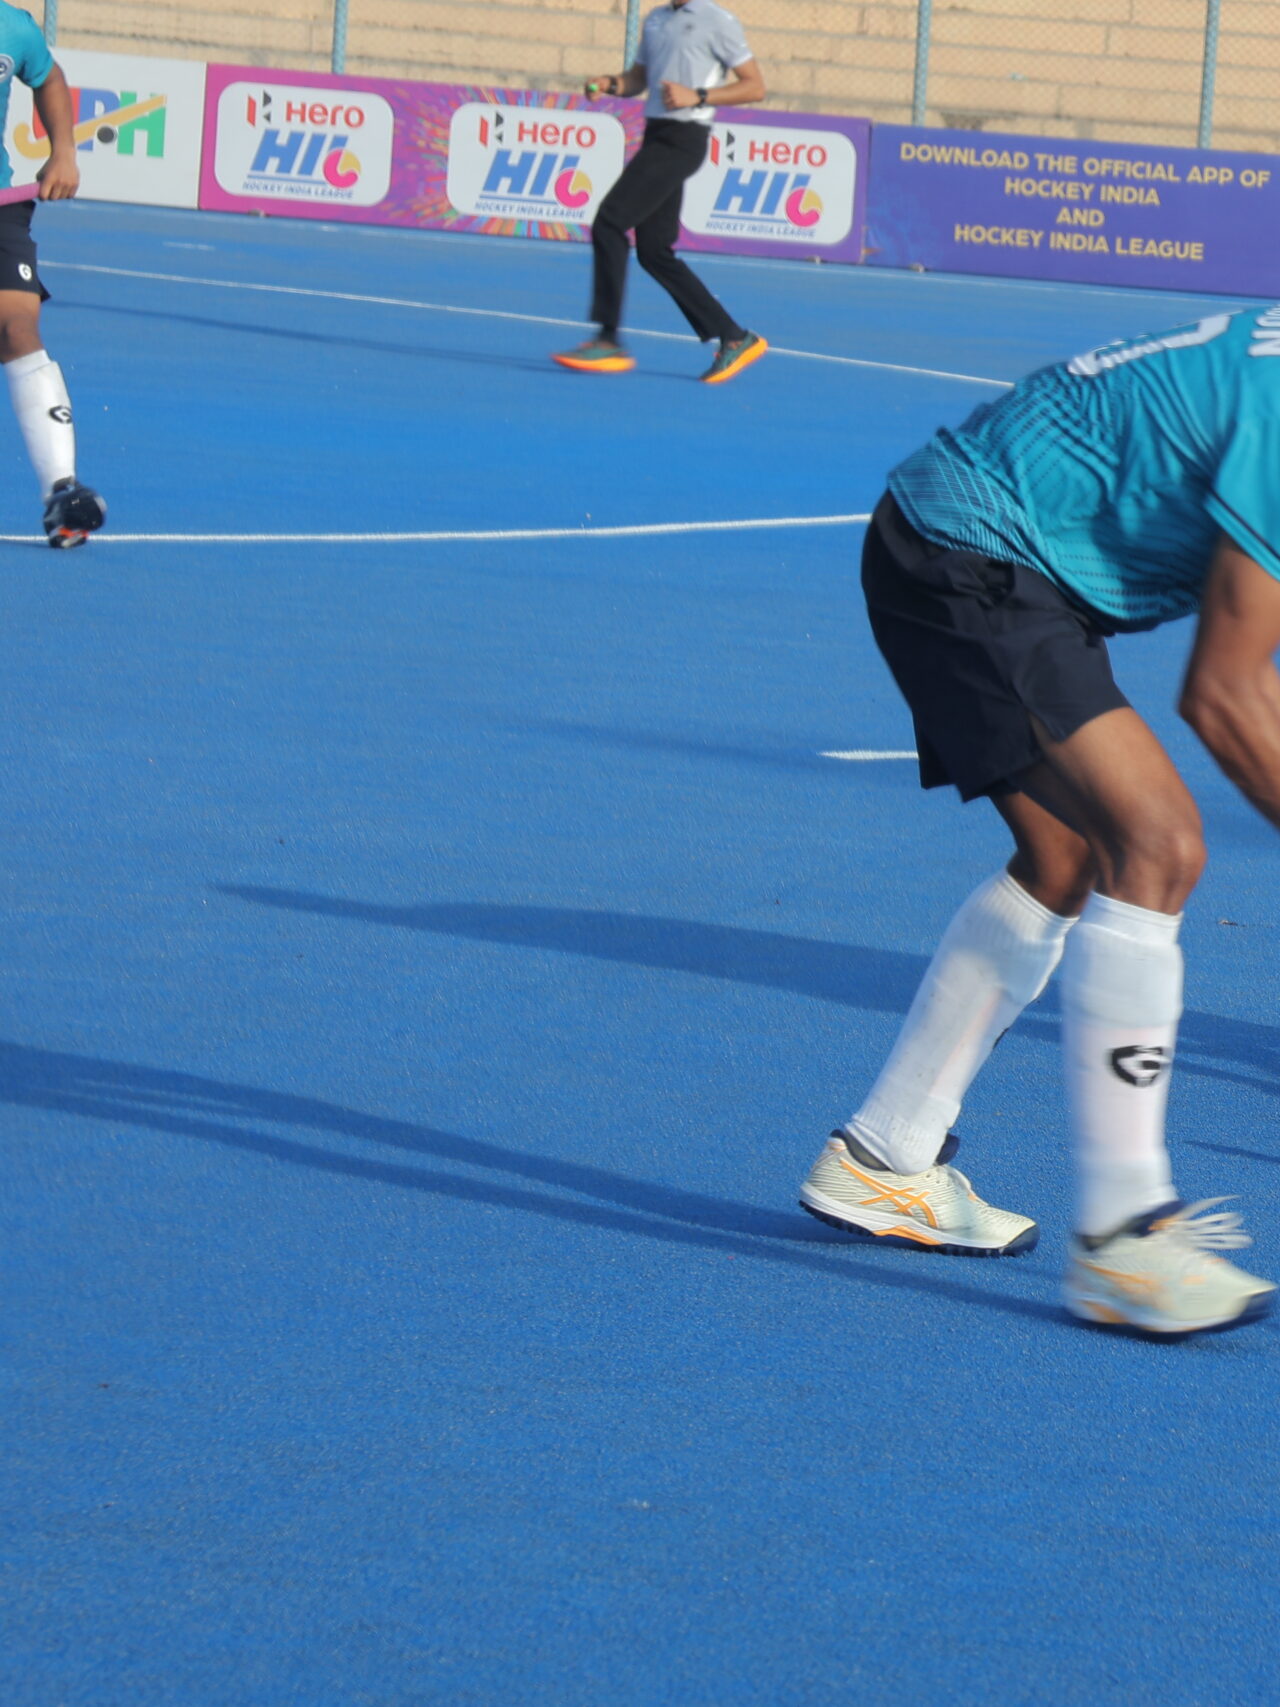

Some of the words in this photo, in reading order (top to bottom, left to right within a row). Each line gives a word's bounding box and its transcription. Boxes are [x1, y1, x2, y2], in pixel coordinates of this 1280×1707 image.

[285, 100, 365, 129] Hero
[517, 120, 597, 149] Hero
[748, 139, 828, 168] Hero
[900, 142, 1030, 170] DOWNLOAD
[1034, 153, 1078, 174] THE
[1082, 157, 1181, 182] OFFICIAL
[1186, 165, 1234, 185] APP
[1239, 169, 1271, 188] OF
[242, 181, 281, 193] HOCKEY
[284, 183, 312, 196] INDIA
[314, 185, 354, 199] LEAGUE
[1004, 176, 1095, 201] HOCKEY
[1100, 183, 1161, 206] INDIA
[474, 201, 513, 213] HOCKEY
[515, 203, 545, 216] INDIA
[546, 206, 586, 219] LEAGUE
[1056, 207, 1106, 227] AND
[705, 220, 746, 232] HOCKEY
[747, 222, 775, 235] INDIA
[776, 224, 816, 238] LEAGUE
[953, 223, 1044, 248] HOCKEY
[1049, 231, 1110, 254] INDIA
[1115, 236, 1205, 261] LEAGUE
